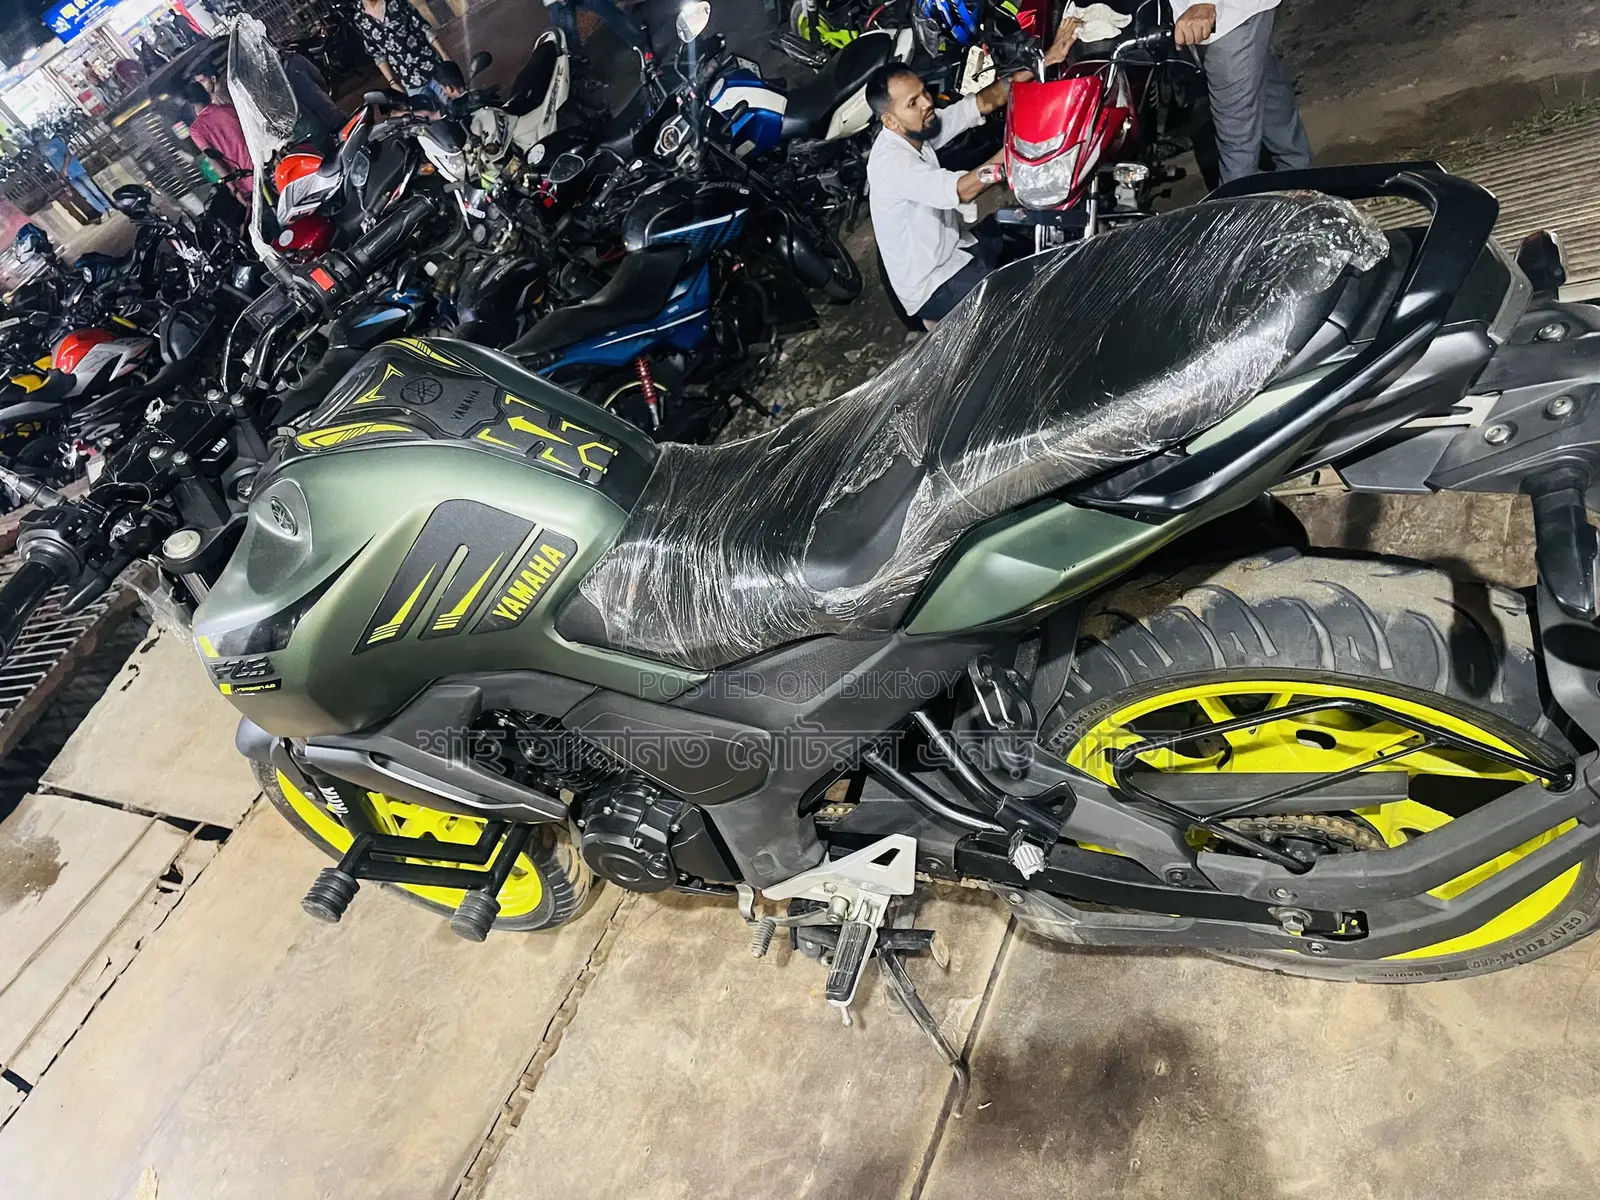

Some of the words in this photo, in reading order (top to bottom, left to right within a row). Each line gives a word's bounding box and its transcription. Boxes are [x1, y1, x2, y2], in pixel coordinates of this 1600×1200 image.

[450, 389, 482, 420] YAMAHA
[491, 543, 566, 621] YAMAHA
[1550, 916, 1583, 944] CEAT
